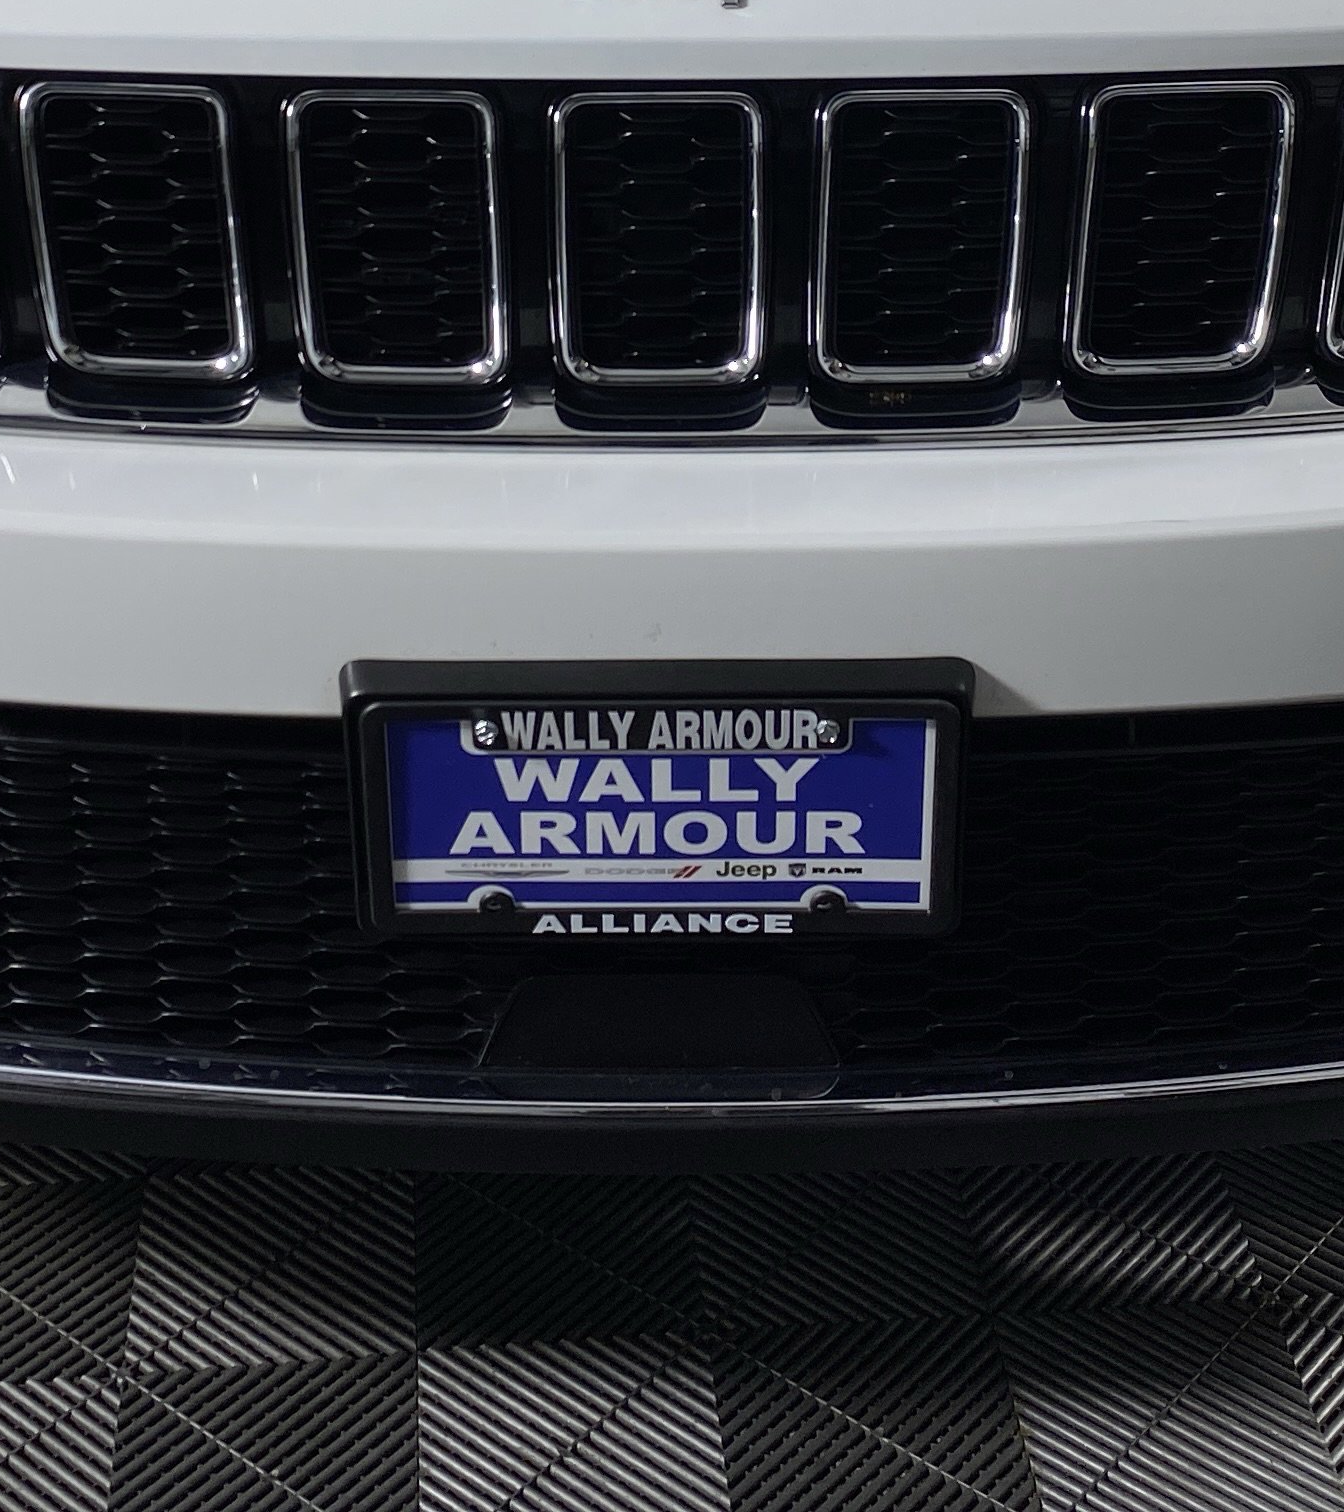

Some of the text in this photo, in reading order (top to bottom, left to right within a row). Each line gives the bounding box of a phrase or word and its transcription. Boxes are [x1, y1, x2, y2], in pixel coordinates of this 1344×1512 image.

[500, 709, 820, 750] WALLY ARMOUR
[493, 758, 820, 802] WALLY
[449, 811, 865, 855] ARMOUR
[716, 861, 777, 880] Jeep
[812, 867, 863, 875] RAM
[532, 913, 794, 935] ALLIANCE
